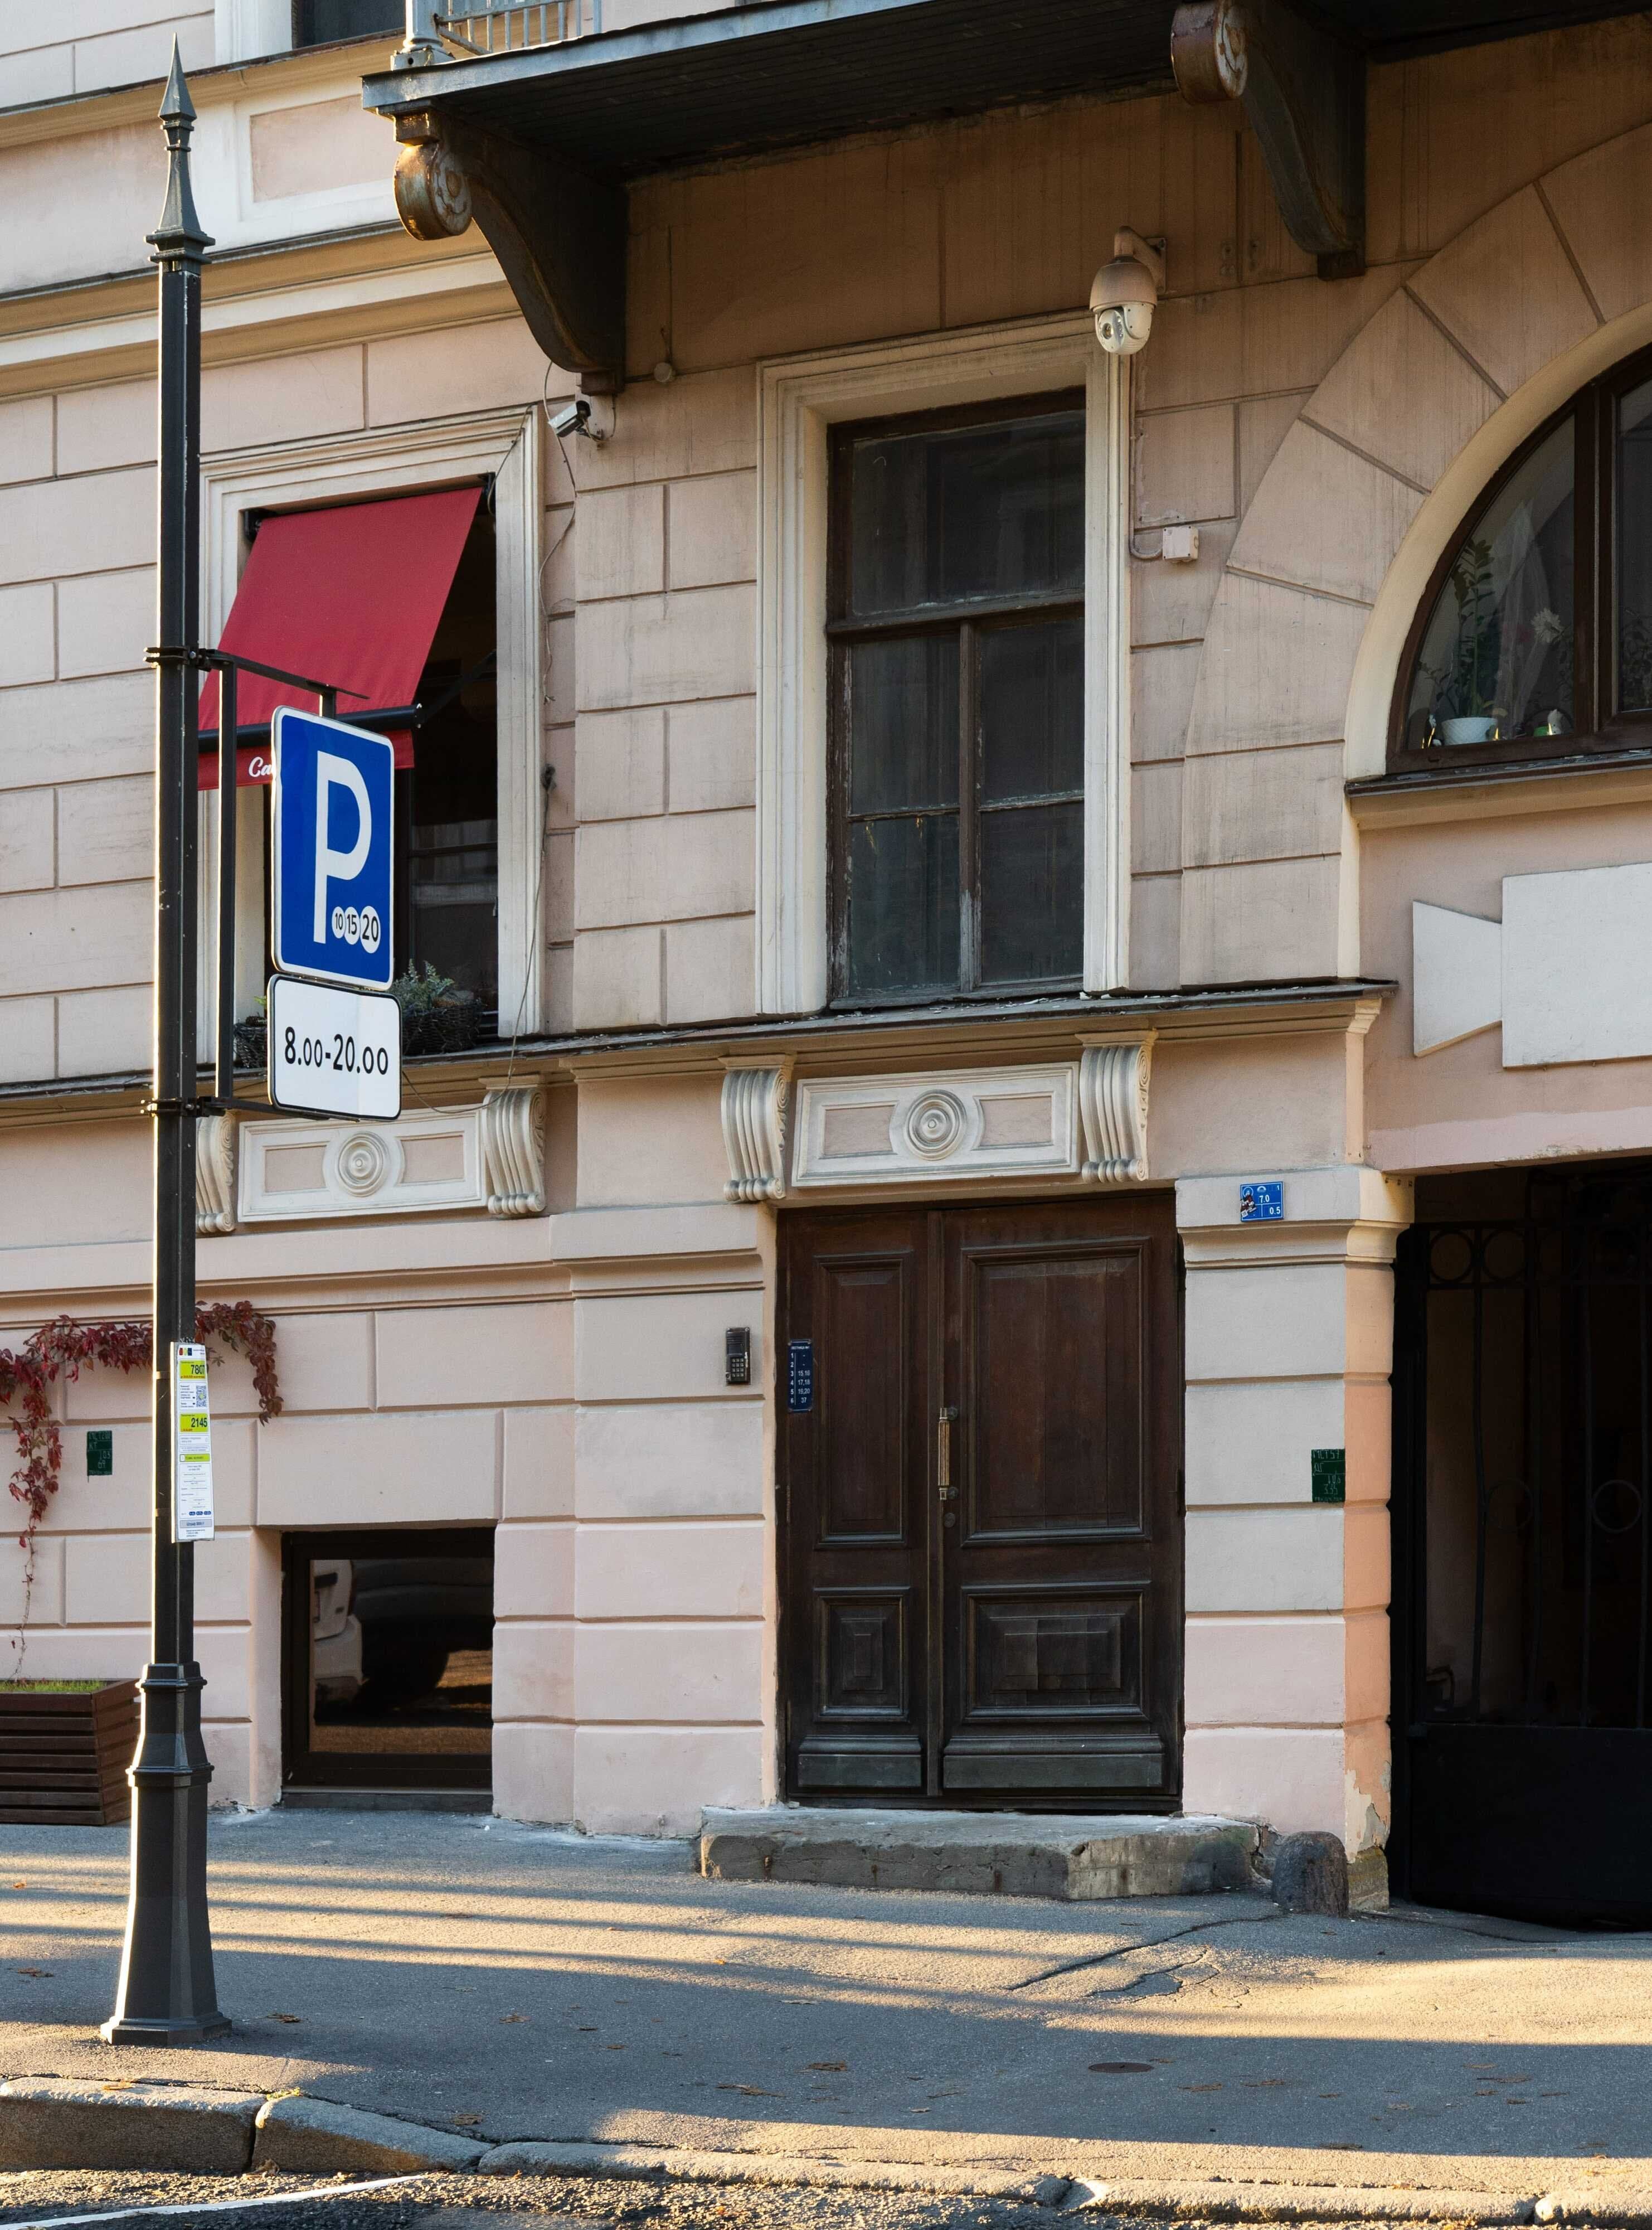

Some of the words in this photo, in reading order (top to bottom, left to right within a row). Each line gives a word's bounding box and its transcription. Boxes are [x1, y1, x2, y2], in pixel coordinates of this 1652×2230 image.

[313, 750, 372, 944] P
[335, 913, 343, 930] 10
[347, 914, 357, 935] 15
[362, 914, 379, 942] 20
[285, 1026, 388, 1075] 8.00-20.00
[191, 1417, 208, 1428] 2145
